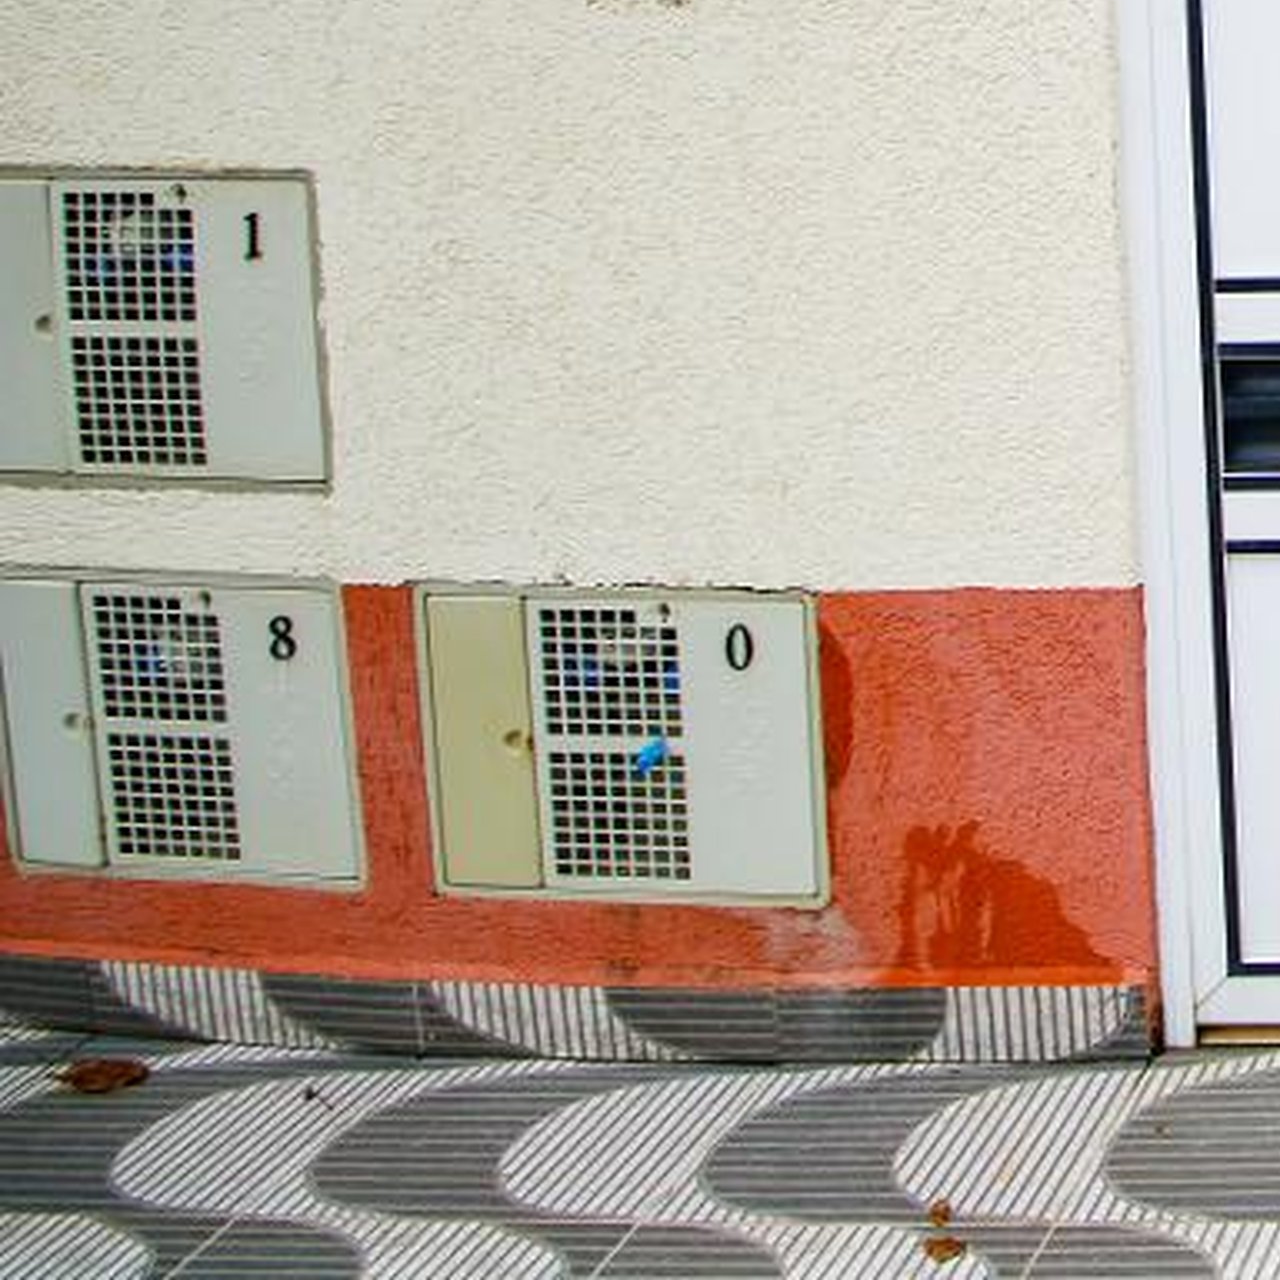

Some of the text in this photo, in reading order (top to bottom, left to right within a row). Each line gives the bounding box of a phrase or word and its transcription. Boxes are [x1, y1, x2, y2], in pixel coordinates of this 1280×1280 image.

[243, 213, 263, 261] 1
[268, 615, 297, 660] 8
[726, 624, 754, 670] 0
